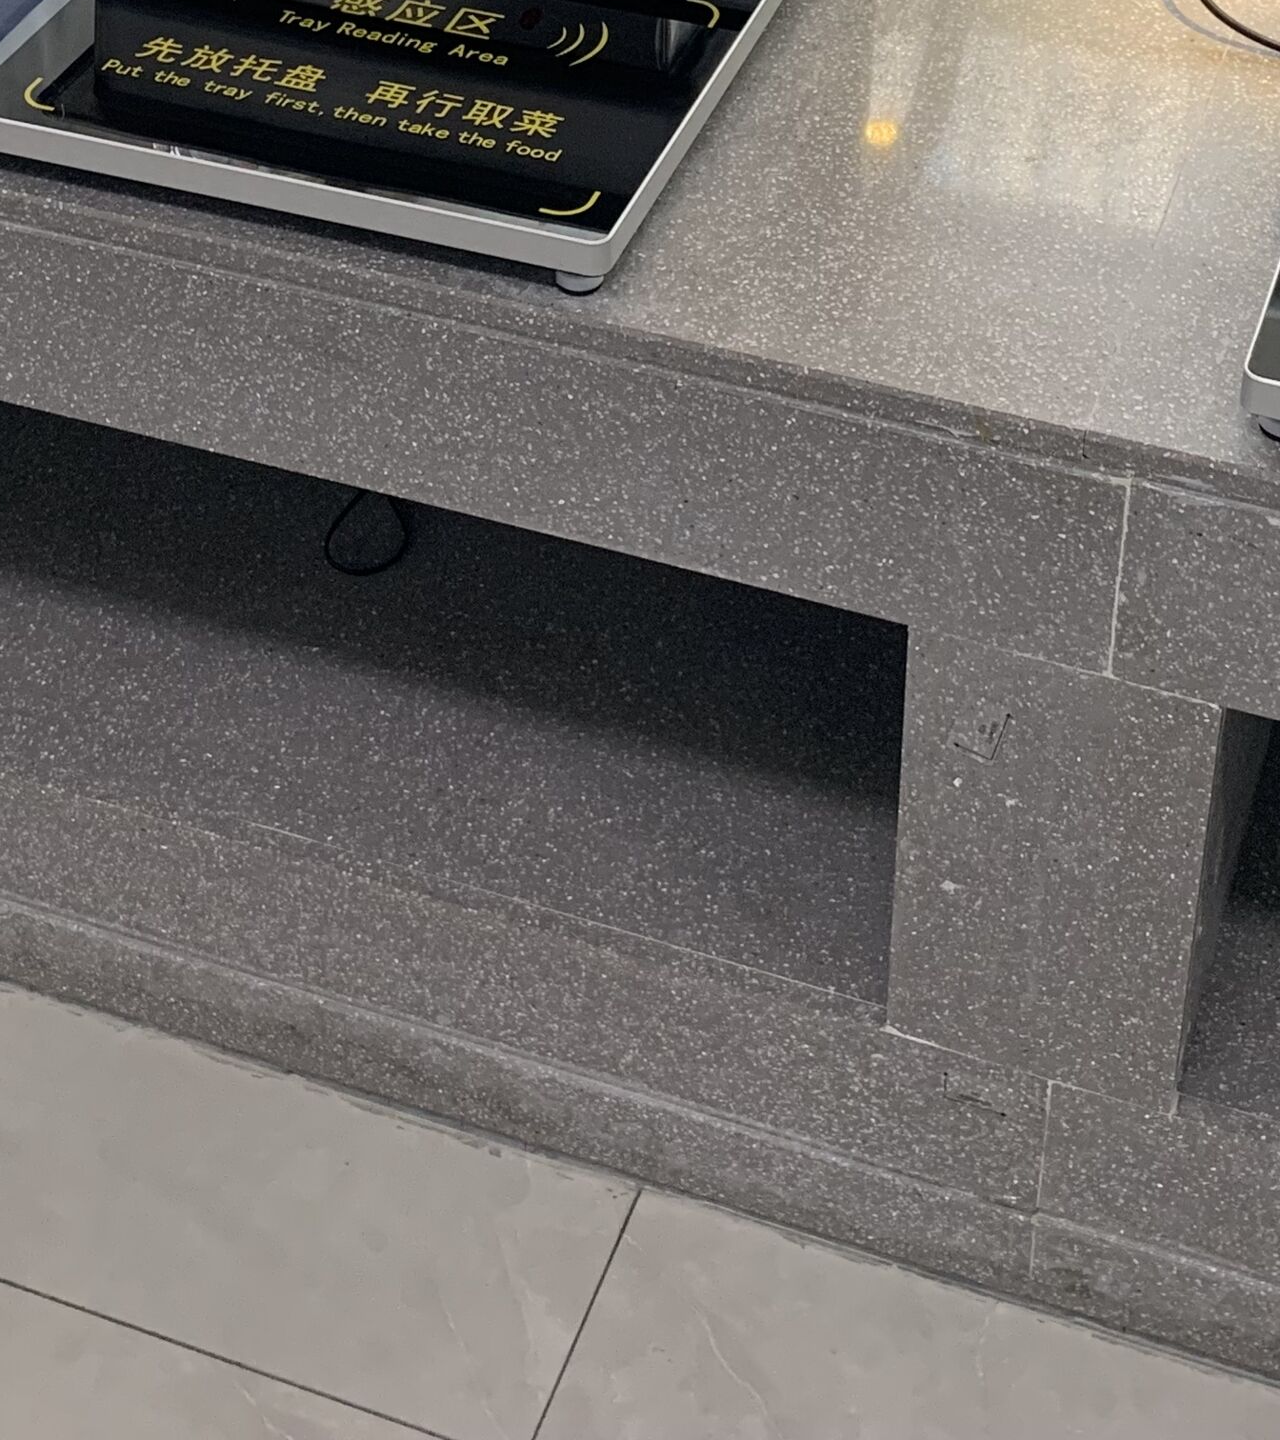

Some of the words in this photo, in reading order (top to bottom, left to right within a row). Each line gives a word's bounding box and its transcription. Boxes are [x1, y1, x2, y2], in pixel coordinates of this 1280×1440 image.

[134, 36, 327, 94] 先放托盘
[364, 80, 566, 140] 再行取菜
[279, 9, 328, 33] Tray
[336, 21, 438, 55] Reading
[448, 44, 509, 68] Area
[100, 58, 143, 78] Put
[153, 68, 191, 88] the
[204, 80, 253, 101] tray
[397, 117, 450, 141] take
[457, 128, 497, 151] the
[504, 139, 564, 163] food
